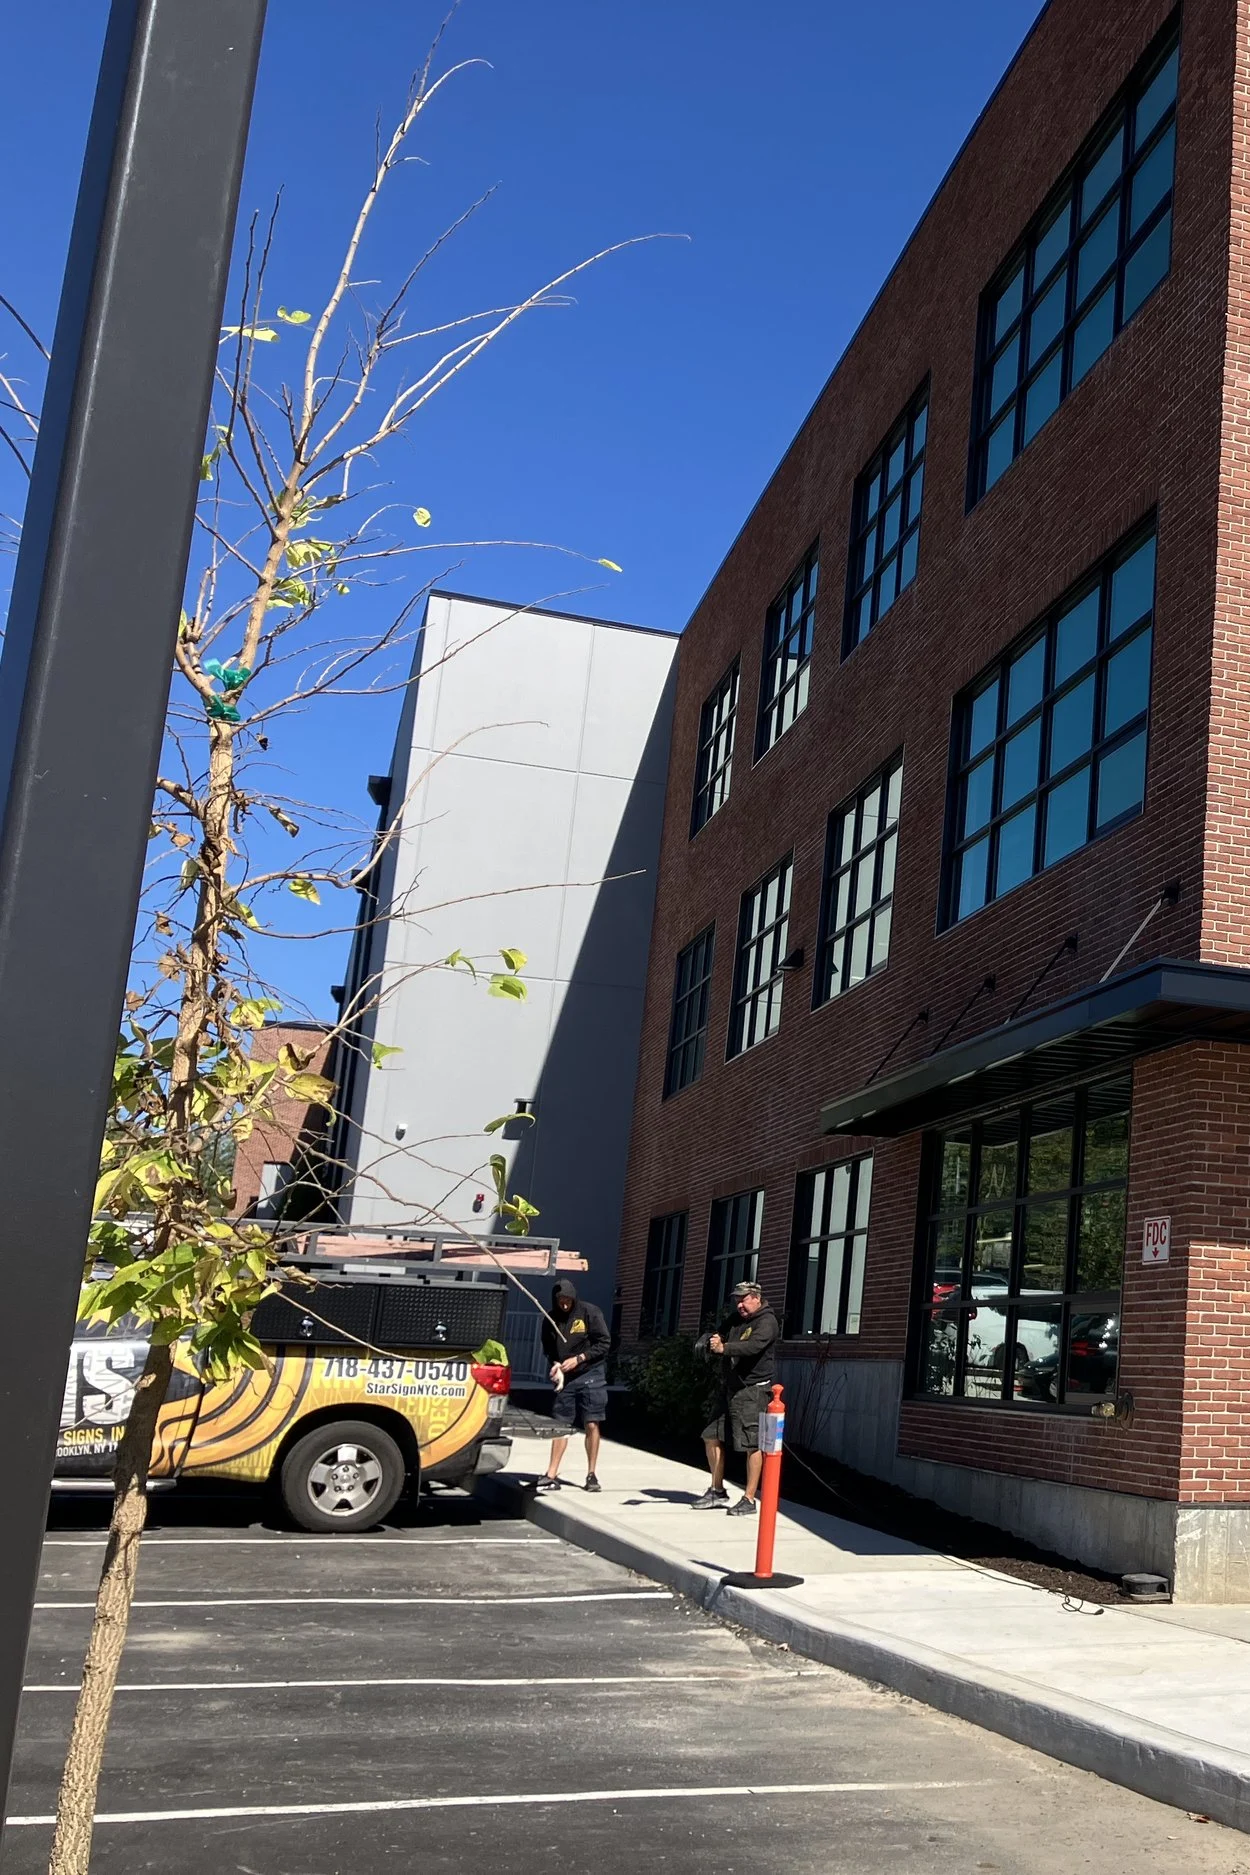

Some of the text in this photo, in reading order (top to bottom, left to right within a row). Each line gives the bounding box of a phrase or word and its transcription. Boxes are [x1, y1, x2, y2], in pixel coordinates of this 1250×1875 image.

[1146, 1221, 1167, 1247] FDC
[324, 1356, 467, 1382] 718-437-0540
[366, 1382, 466, 1397] StarSignNYC.com
[63, 1425, 125, 1446] SIGNS, IN
[94, 1442, 106, 1454] NY
[108, 1441, 118, 1453] 11
